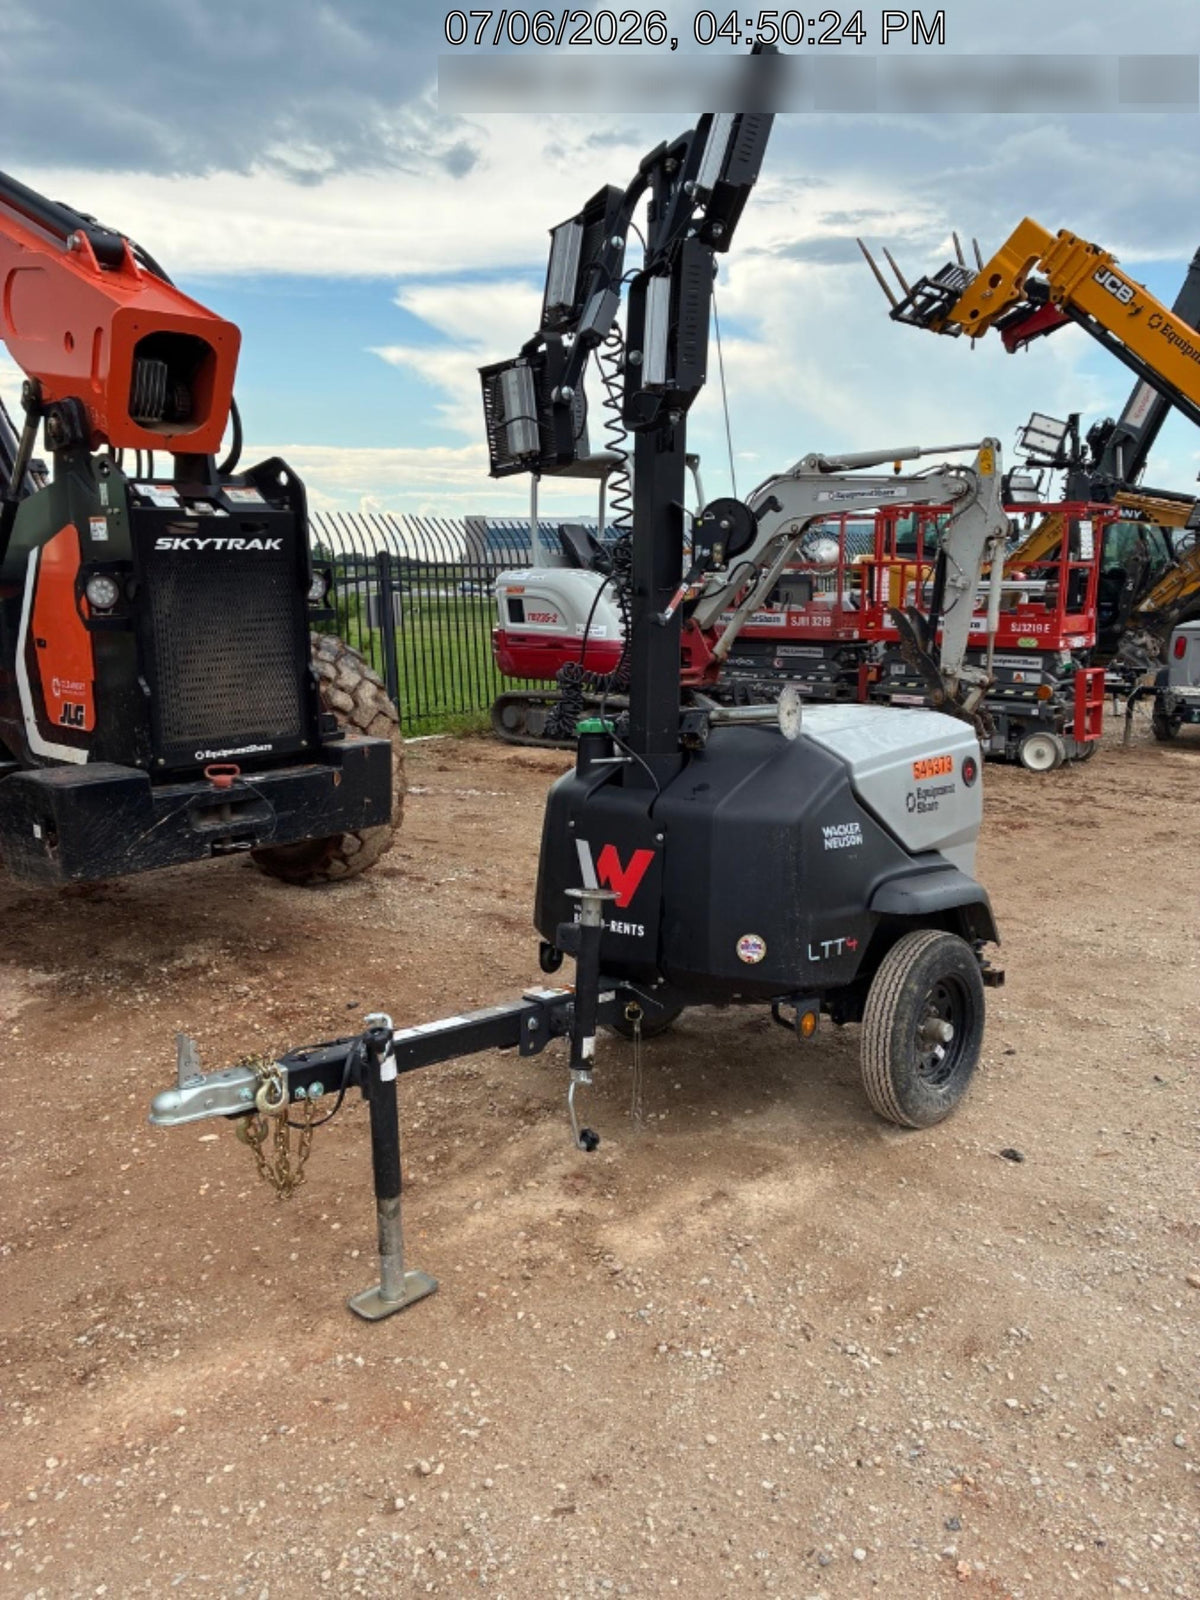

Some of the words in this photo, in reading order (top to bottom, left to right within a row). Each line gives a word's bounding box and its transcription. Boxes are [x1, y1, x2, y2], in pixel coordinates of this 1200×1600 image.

[1094, 269, 1135, 304] JCB
[154, 537, 283, 551] SKYTRAK
[59, 702, 86, 730] JLG
[822, 822, 861, 838] WACKER
[824, 834, 863, 850] NEUSON
[808, 936, 858, 961] LTT4
